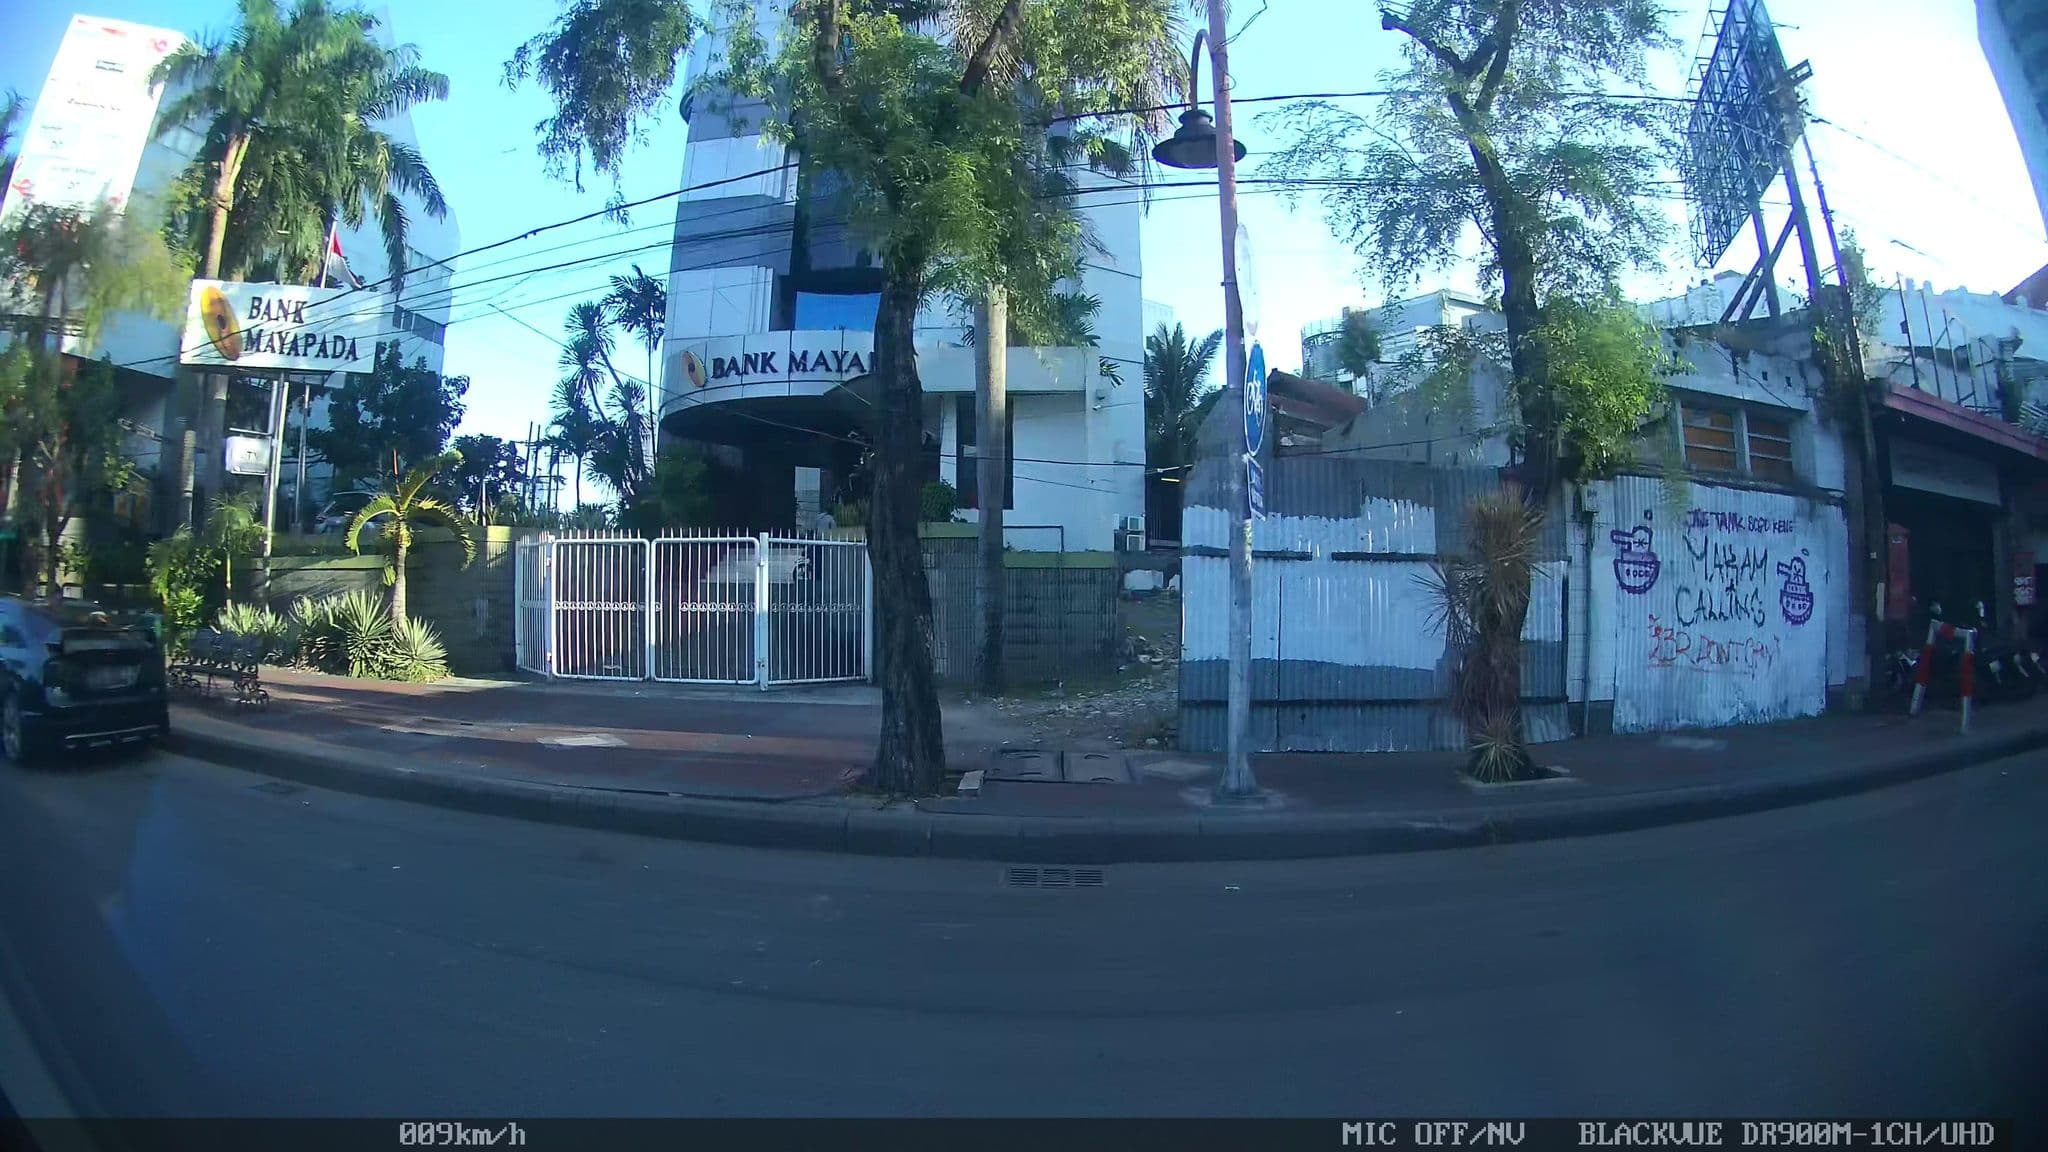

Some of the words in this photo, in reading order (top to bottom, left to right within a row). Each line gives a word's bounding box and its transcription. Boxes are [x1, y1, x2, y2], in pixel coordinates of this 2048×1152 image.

[248, 296, 308, 324] BANK
[244, 328, 359, 361] MAYAPADA
[711, 351, 778, 379] BANK
